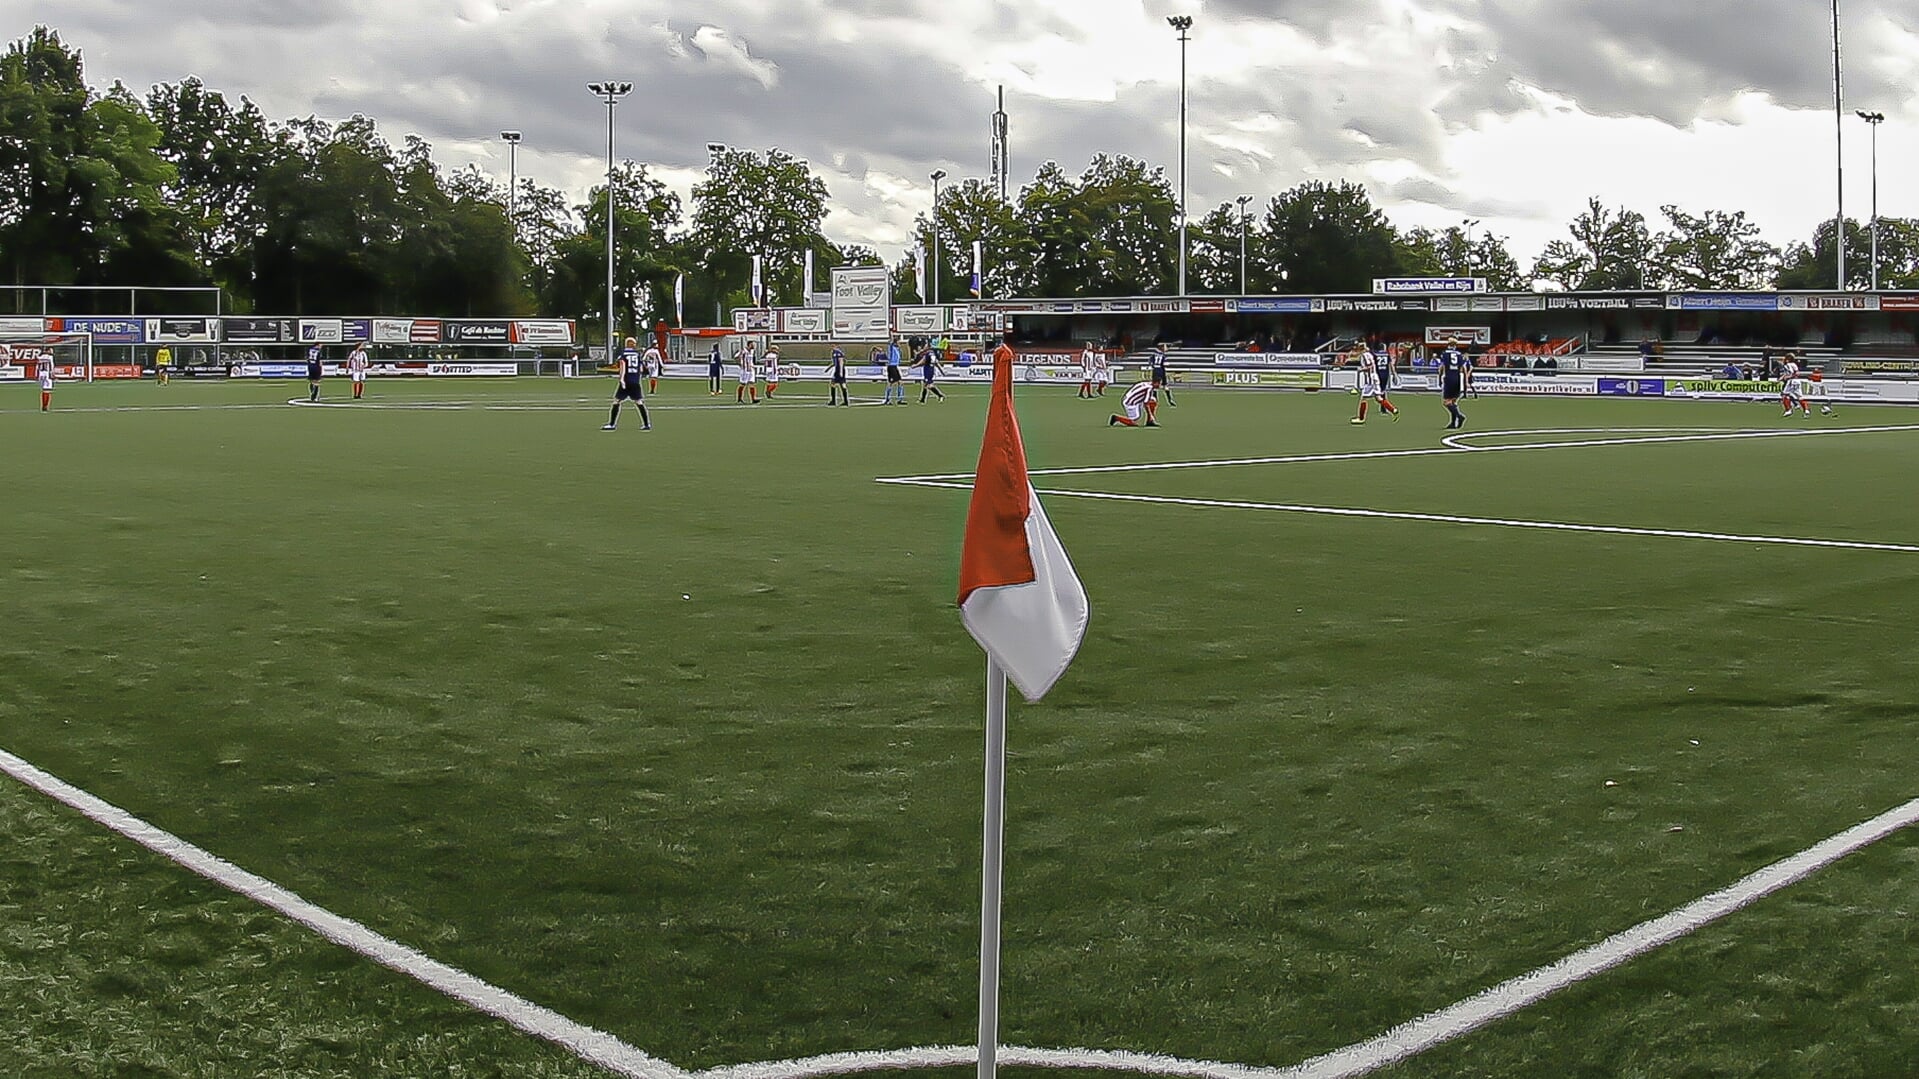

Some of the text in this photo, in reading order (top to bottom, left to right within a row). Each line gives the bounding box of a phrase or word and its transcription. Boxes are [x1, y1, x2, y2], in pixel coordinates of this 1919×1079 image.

[835, 284, 884, 299] Foot Valley
[1387, 281, 1424, 291] Rabobank
[1425, 281, 1445, 290] Vallei
[1354, 301, 1398, 311] VOETBAL
[1548, 298, 1578, 309] 100%
[1579, 298, 1629, 309] VOETBAL
[74, 322, 122, 333] DE NUDE
[625, 355, 639, 368] 15
[1020, 354, 1072, 365] LEGENDS
[1376, 356, 1388, 366] 23
[1450, 353, 1458, 365] 5
[1225, 373, 1259, 384] PLUS
